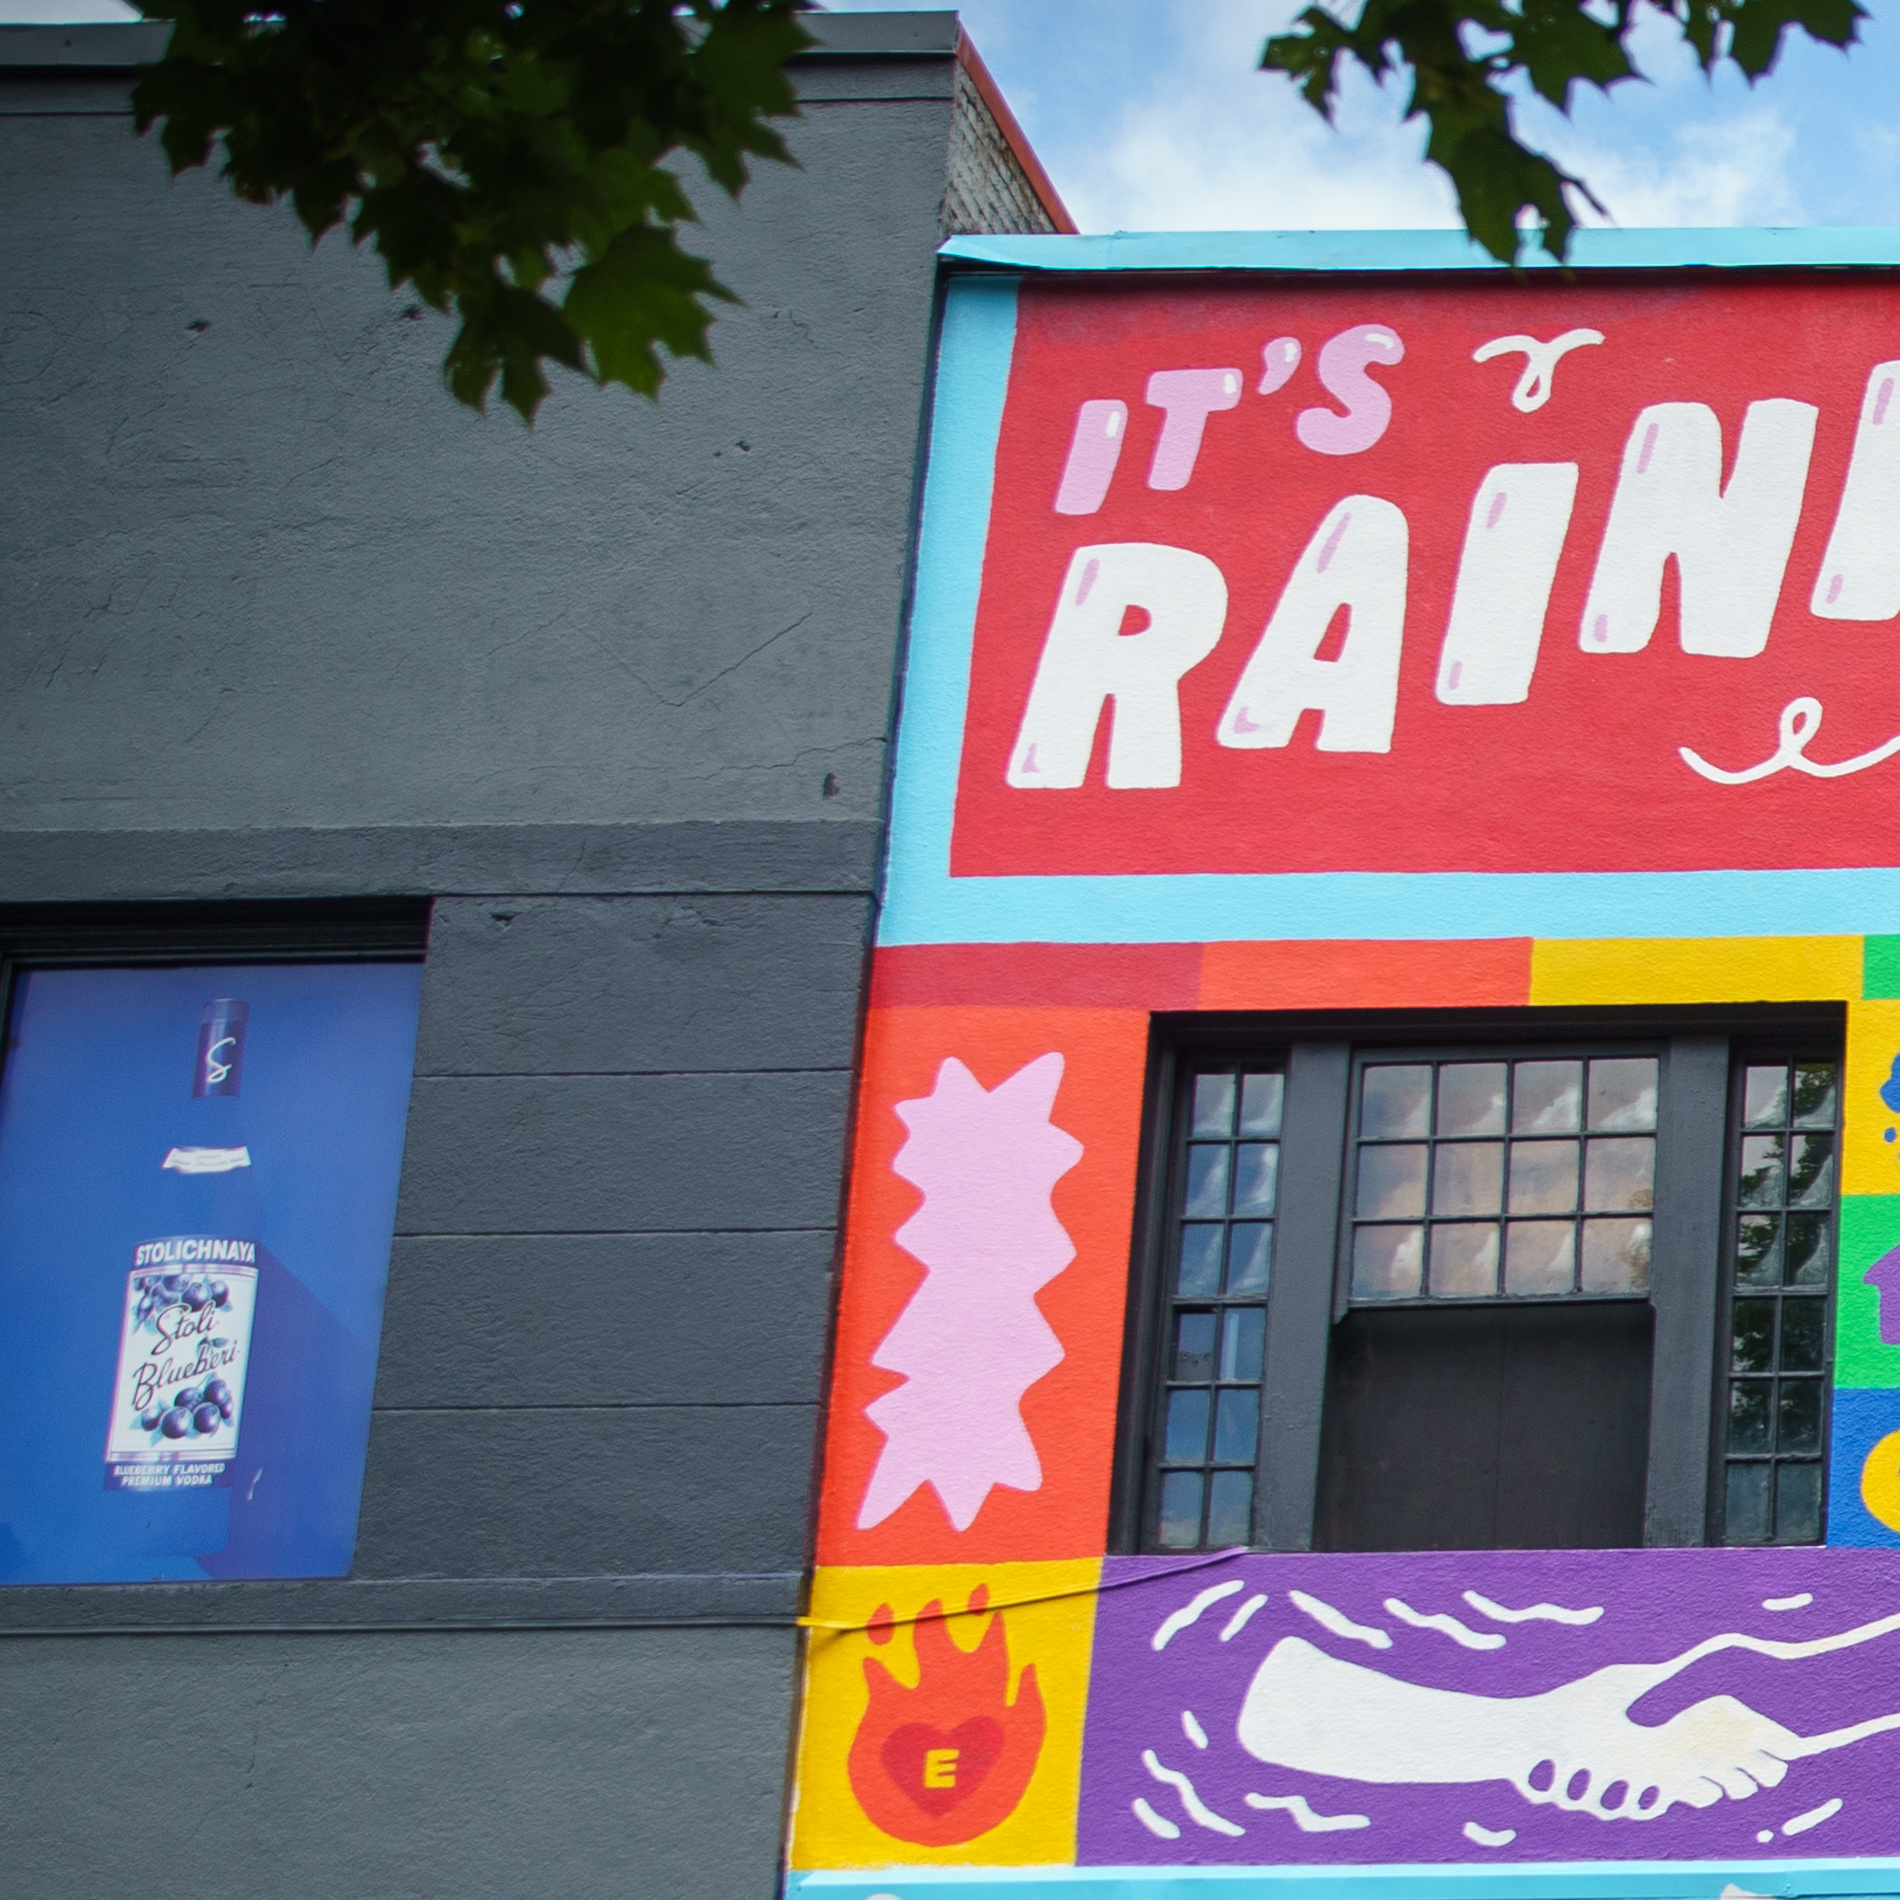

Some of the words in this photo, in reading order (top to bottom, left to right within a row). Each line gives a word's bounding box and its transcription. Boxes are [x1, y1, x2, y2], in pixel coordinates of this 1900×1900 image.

[1054, 324, 1405, 516] IT'S
[136, 1239, 256, 1266] STOLICHNAYA
[151, 1299, 216, 1356] Stoli
[132, 1339, 239, 1412] Blueberi
[113, 1464, 171, 1476] BLUEBERRY
[173, 1462, 226, 1475] FLAVORED
[122, 1474, 172, 1487] PREMIUM
[175, 1473, 213, 1486] VODKA
[923, 1748, 961, 1790] E
